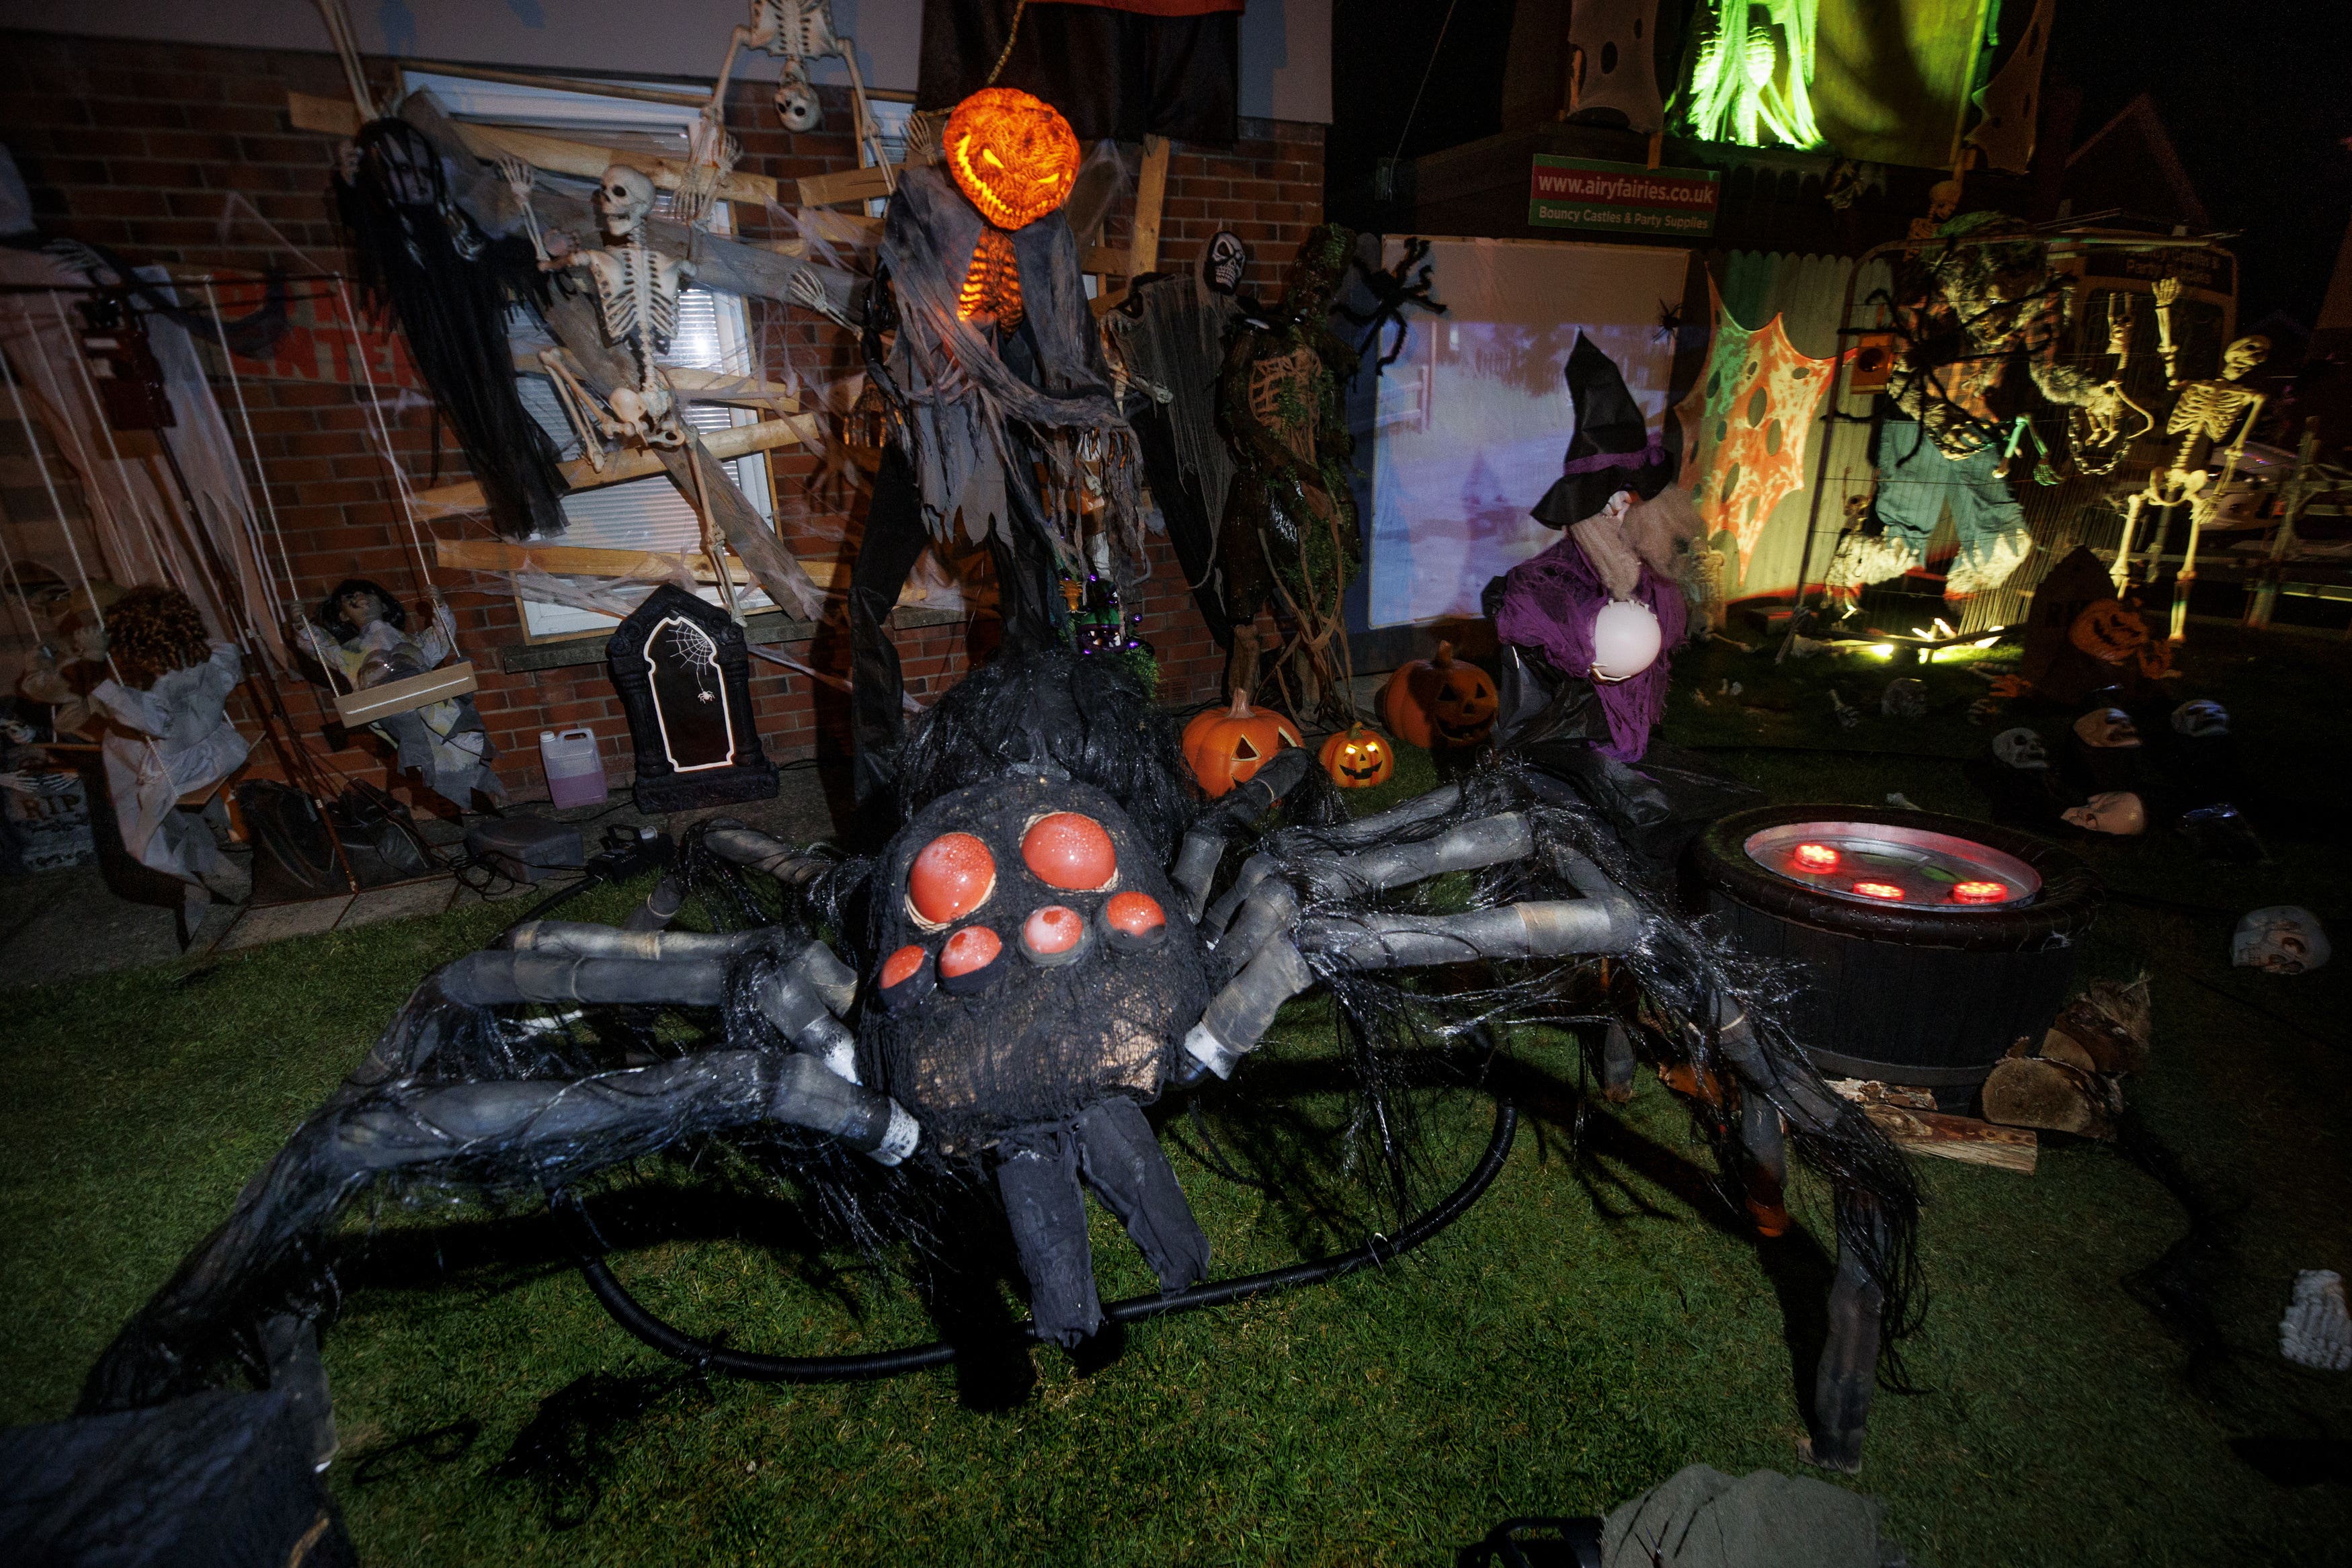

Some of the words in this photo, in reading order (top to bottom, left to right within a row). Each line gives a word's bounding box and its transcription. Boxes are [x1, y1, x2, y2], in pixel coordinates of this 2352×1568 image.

[1538, 176, 1713, 203] www.airyfairies.co.uk
[1539, 205, 1580, 222] Bouncy
[1583, 208, 1621, 224] Castles
[1623, 212, 1631, 224] &
[1634, 212, 1662, 227] Party
[1664, 214, 1708, 231] Supplies
[22, 794, 79, 820] RIP
